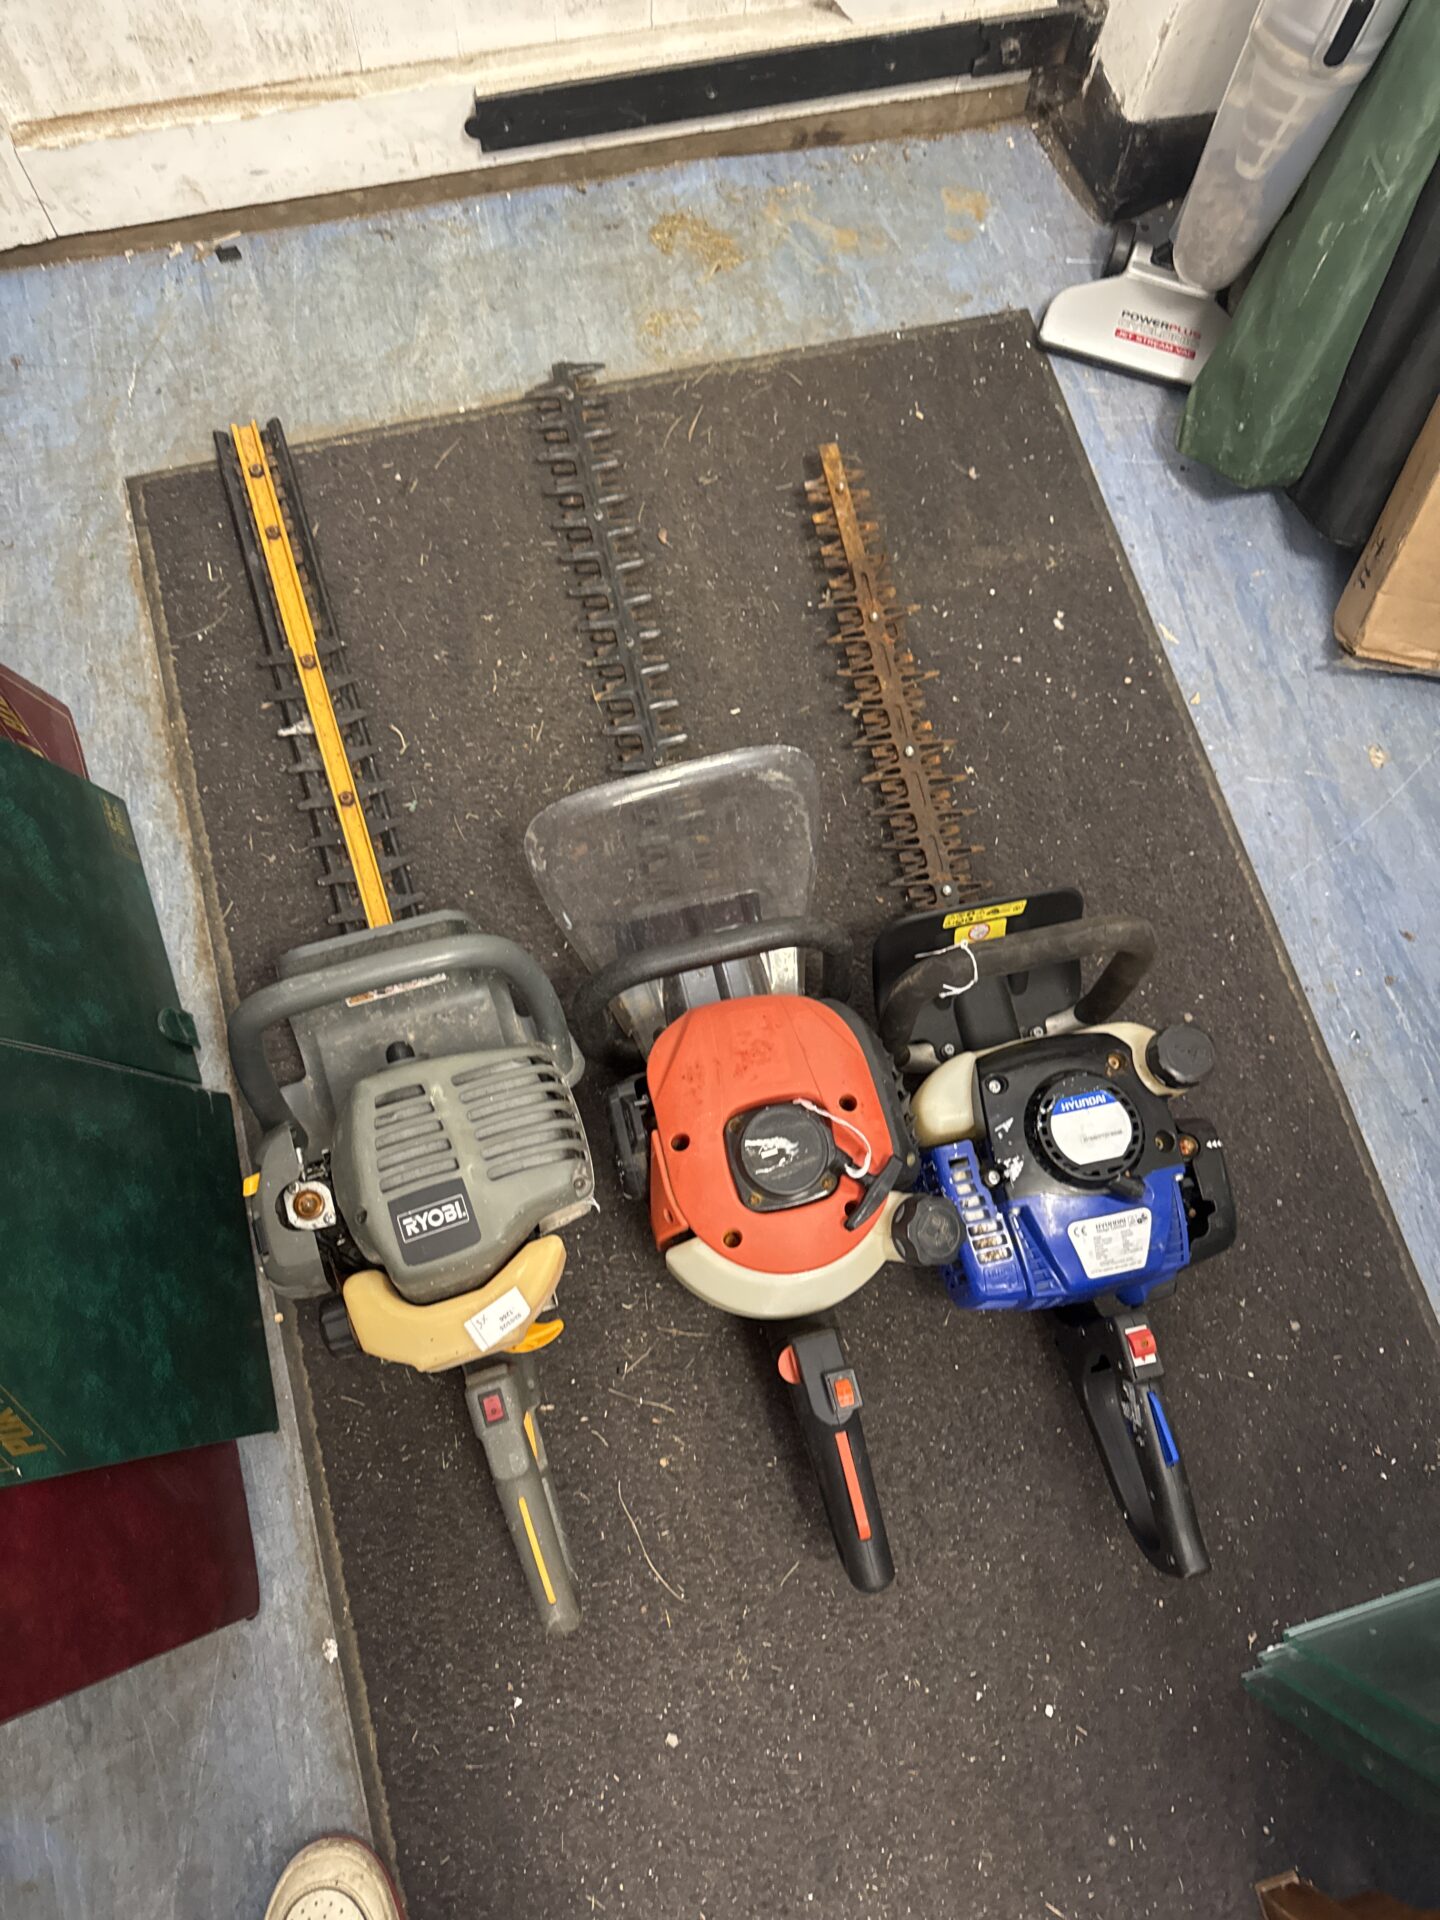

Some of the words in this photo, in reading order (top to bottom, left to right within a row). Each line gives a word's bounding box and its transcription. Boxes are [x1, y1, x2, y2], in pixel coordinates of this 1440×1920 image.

[1121, 309, 1201, 340] POWERPLUS
[1117, 328, 1134, 340] JET
[1135, 334, 1173, 353] STREAM
[1060, 1094, 1107, 1112] HYUNDAI
